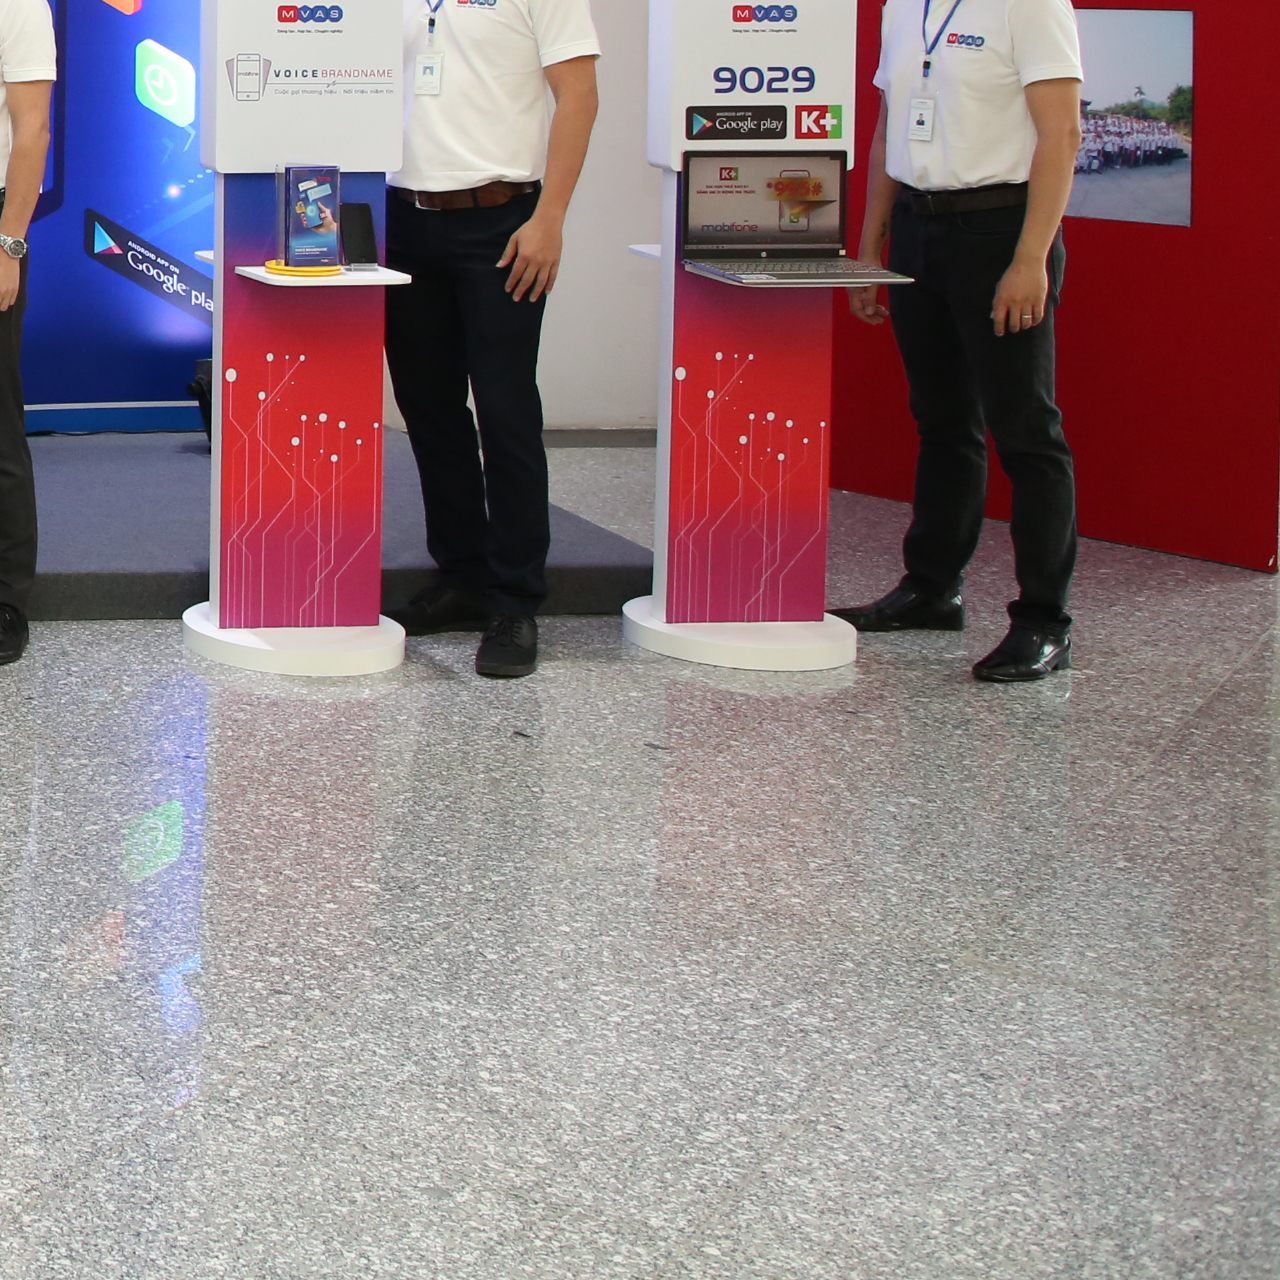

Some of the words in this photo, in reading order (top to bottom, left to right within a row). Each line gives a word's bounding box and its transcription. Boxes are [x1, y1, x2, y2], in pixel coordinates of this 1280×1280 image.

[280, 8, 341, 20] MVAS
[735, 8, 795, 20] MVAS
[274, 70, 318, 78] VOICE
[322, 69, 393, 78] BRANDNAME
[713, 67, 816, 94] 9029
[715, 117, 757, 133] Google
[760, 118, 783, 132] play
[801, 111, 838, 134] K+
[721, 169, 737, 179] K+
[701, 222, 758, 232] mobifone
[128, 241, 156, 260] ANDROID
[157, 258, 169, 267] APP
[169, 265, 179, 274] ON
[127, 251, 186, 295] Google
[192, 290, 213, 312] pla
